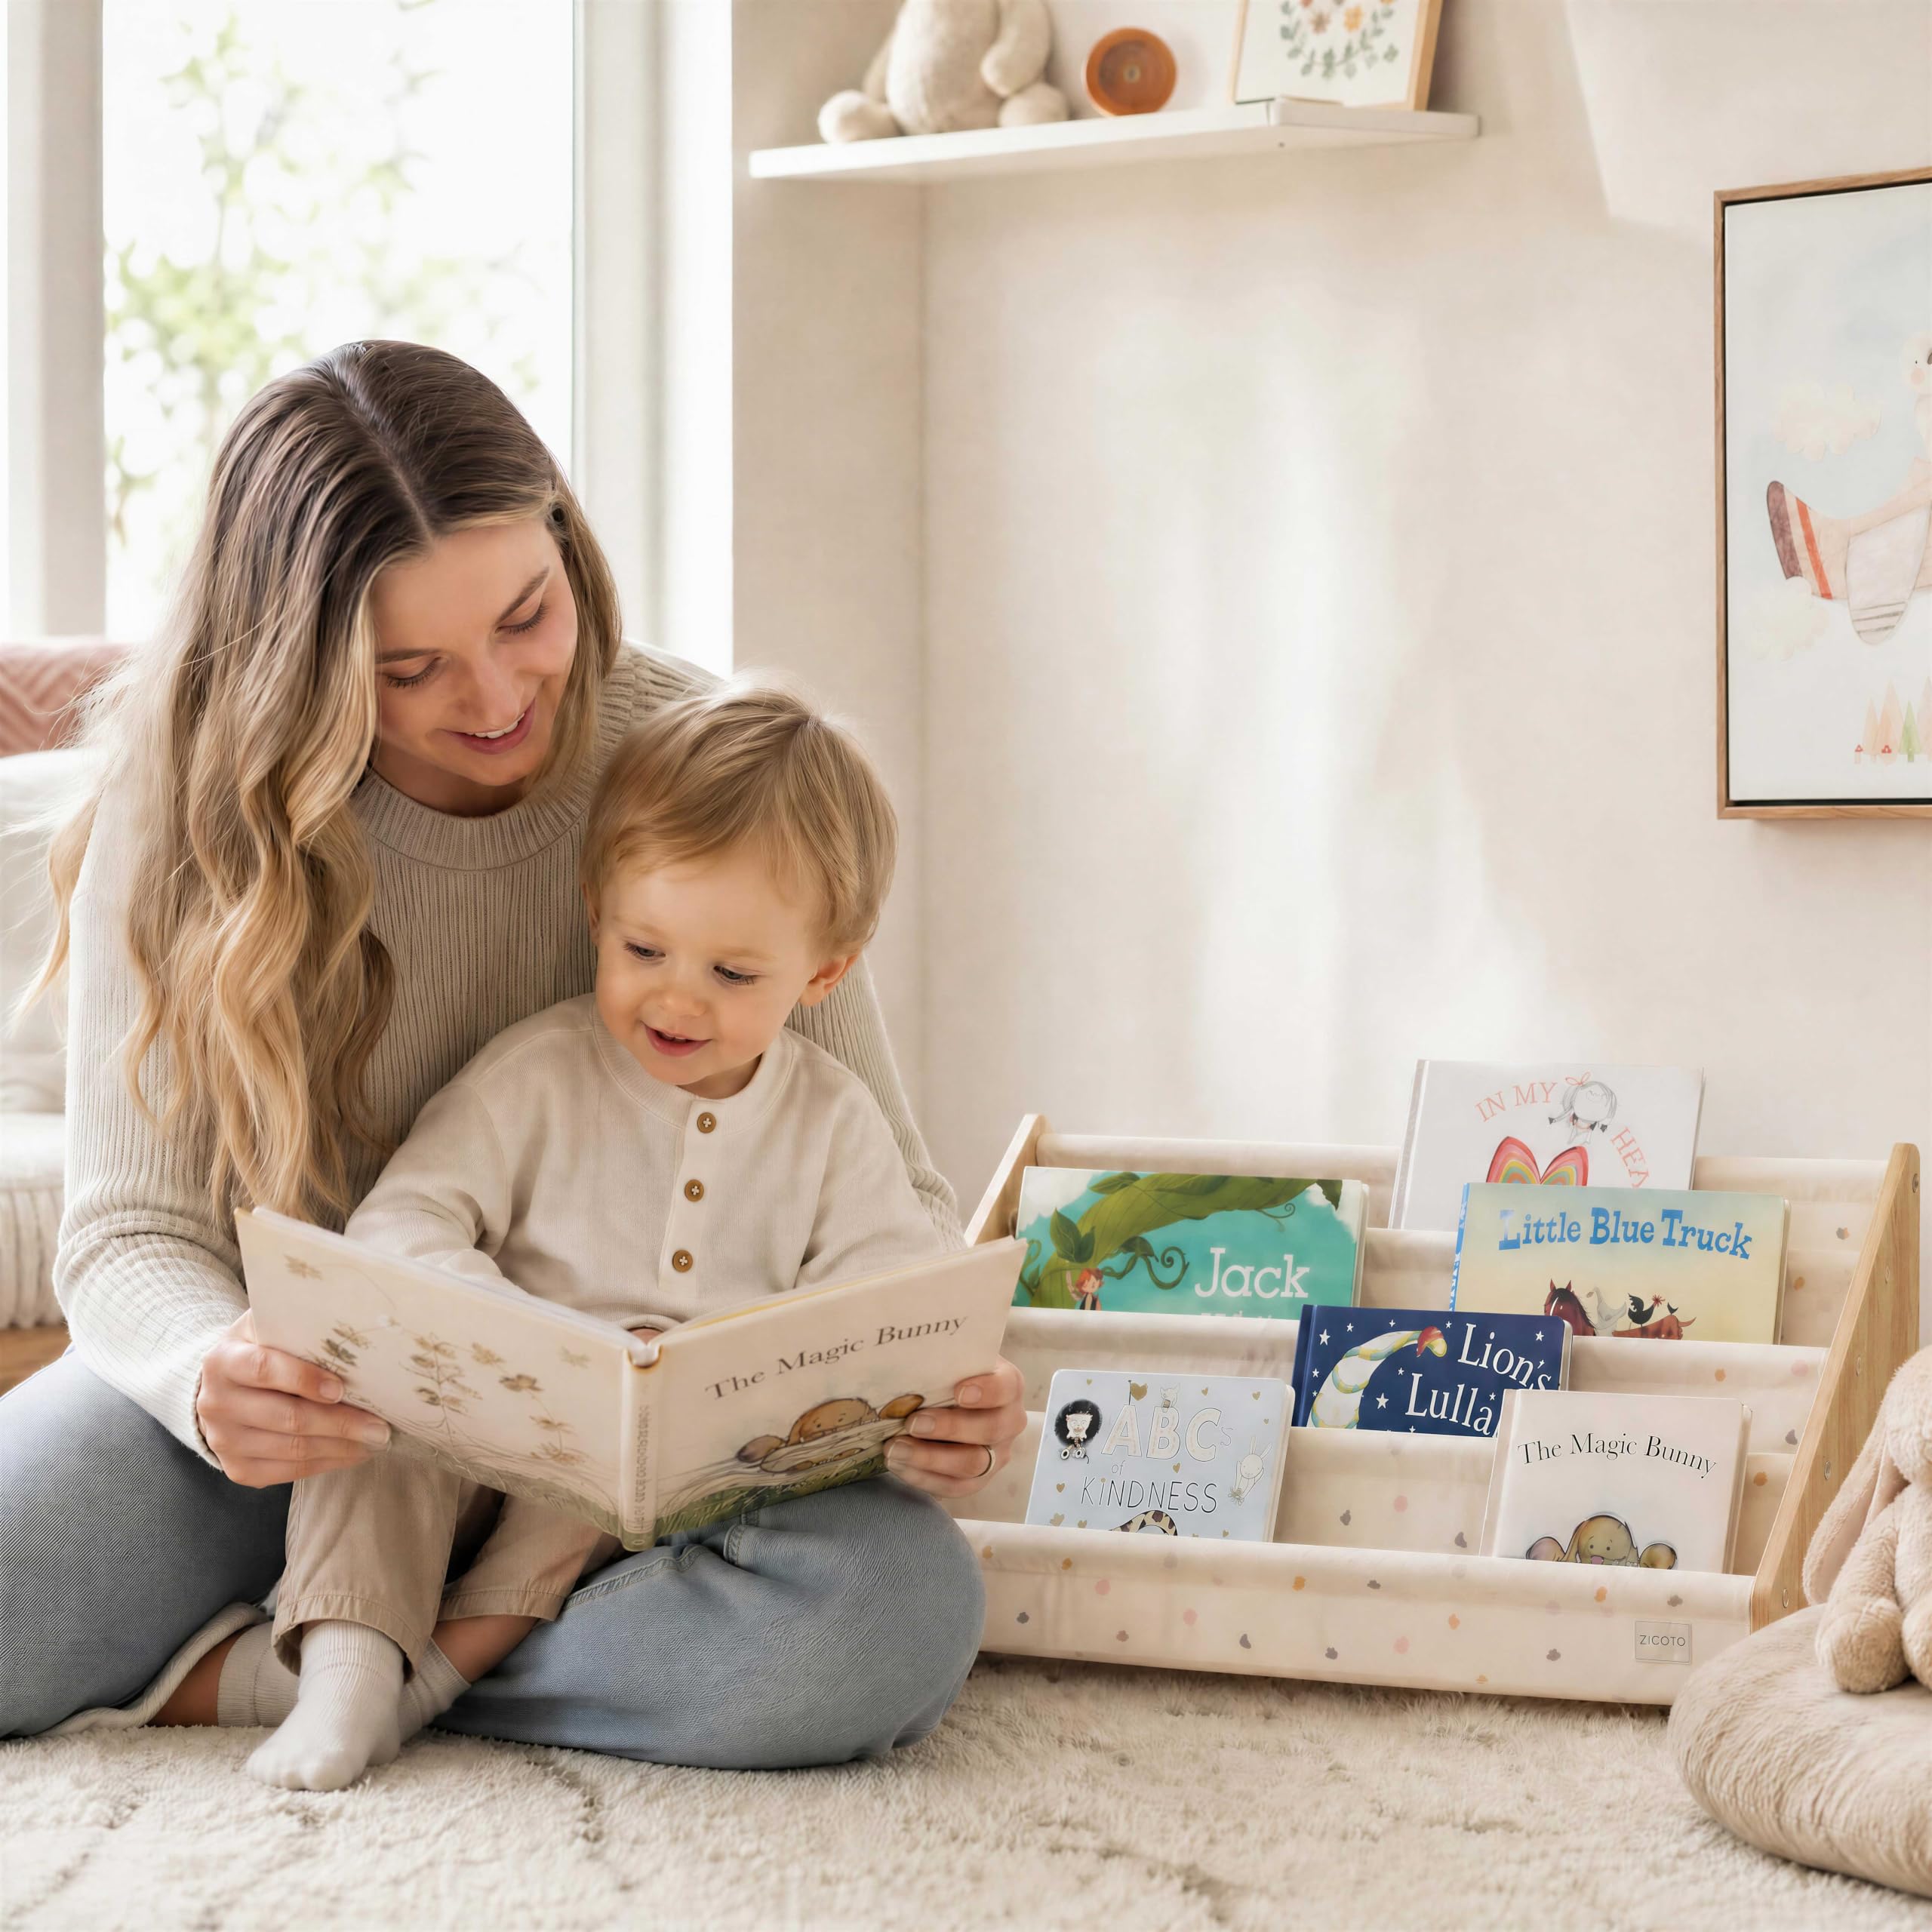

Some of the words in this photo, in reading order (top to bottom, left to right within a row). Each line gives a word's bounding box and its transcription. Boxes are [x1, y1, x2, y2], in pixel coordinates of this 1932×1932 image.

[1475, 1091, 1506, 1122] IN
[1513, 1081, 1558, 1106] MY
[1498, 1209, 1581, 1250] Little
[1589, 1207, 1655, 1244] Blue
[1661, 1208, 1752, 1260] Truck
[1195, 1247, 1310, 1299] Jack
[705, 1371, 765, 1400] The
[776, 1338, 864, 1375] Magic
[874, 1316, 968, 1346] Bunny
[1457, 1323, 1552, 1391] Lion's
[1404, 1372, 1499, 1438] Lulla
[1101, 1404, 1233, 1462] ABCs
[1517, 1440, 1562, 1465] The
[1570, 1432, 1638, 1460] Magic
[1644, 1435, 1717, 1479] Bunny
[1111, 1460, 1127, 1476] of
[1639, 1635, 1686, 1647] ZICOTO
